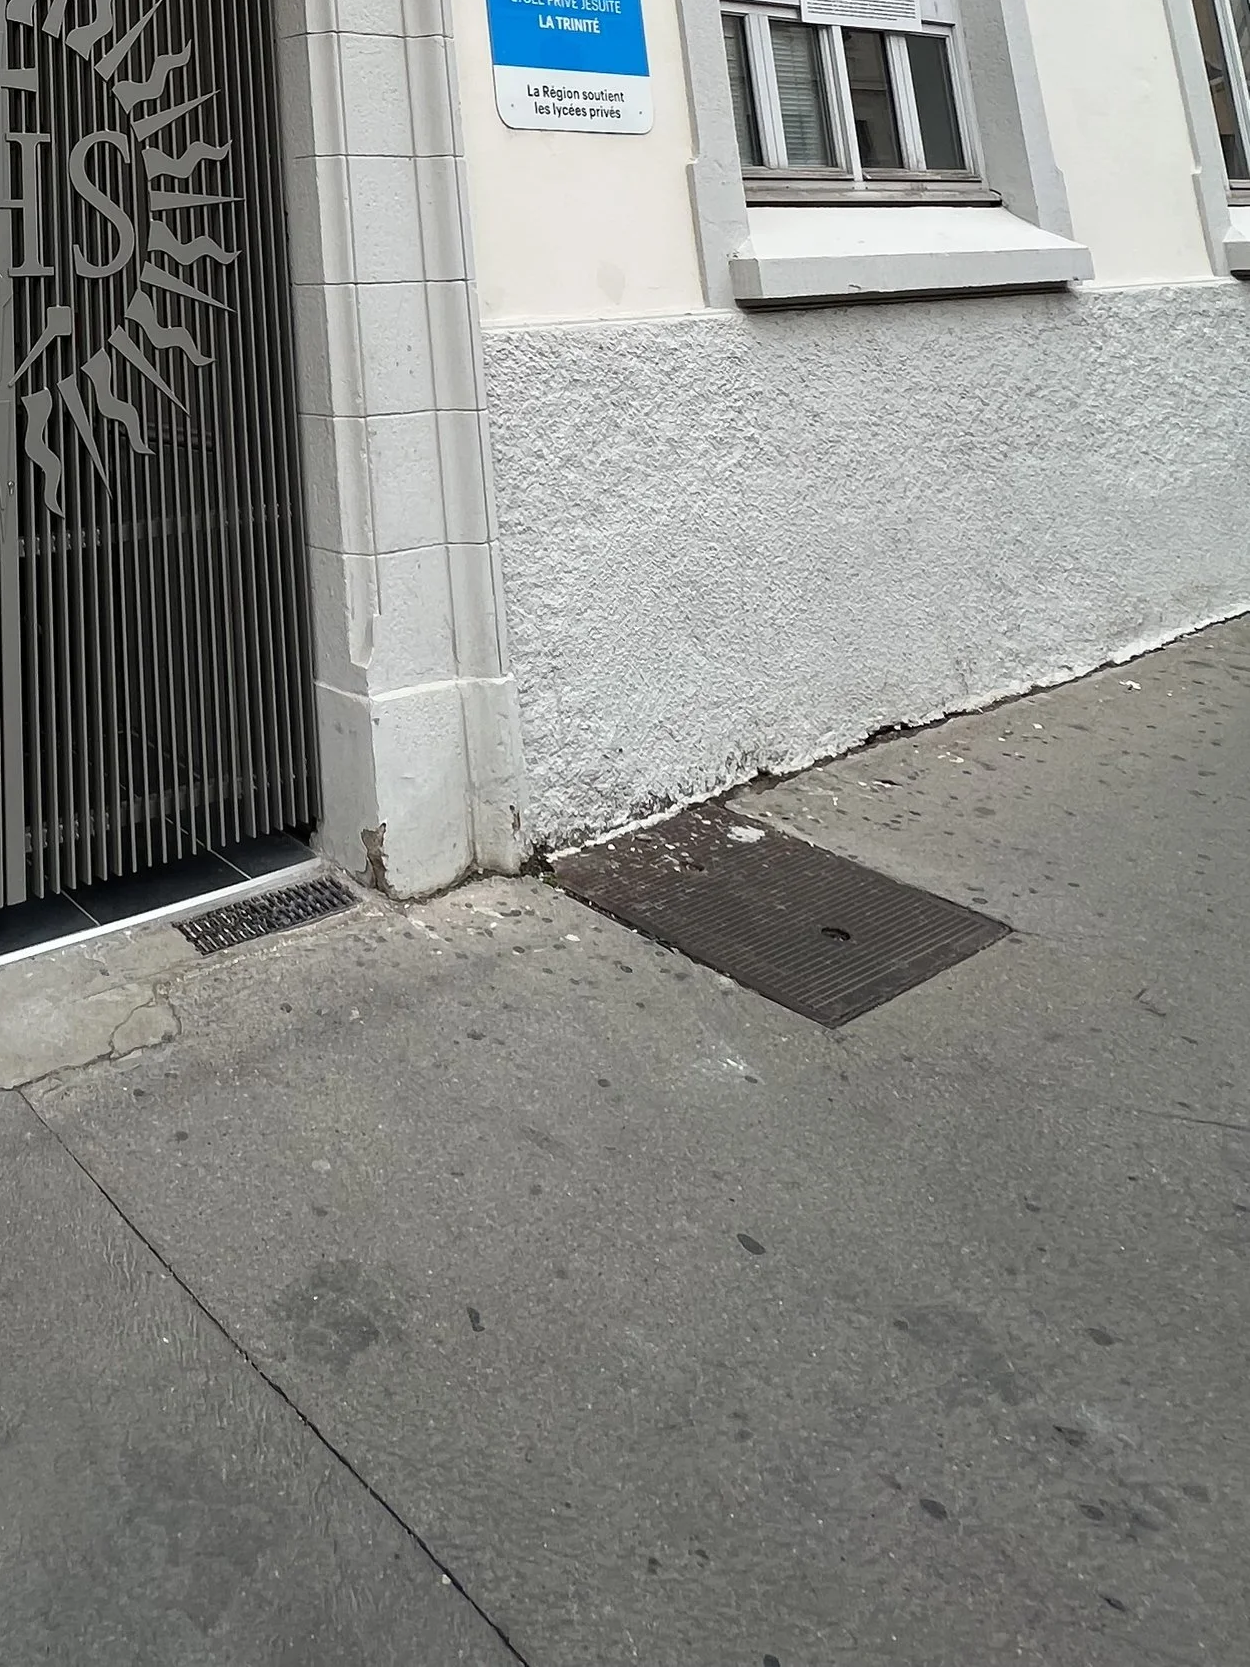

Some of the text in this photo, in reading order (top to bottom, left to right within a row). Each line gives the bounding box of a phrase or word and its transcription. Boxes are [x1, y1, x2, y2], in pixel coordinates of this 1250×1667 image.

[538, 14, 601, 34] LA TRINITÉ
[527, 84, 625, 103] La Région soutient
[534, 101, 621, 120] les lycées privés
